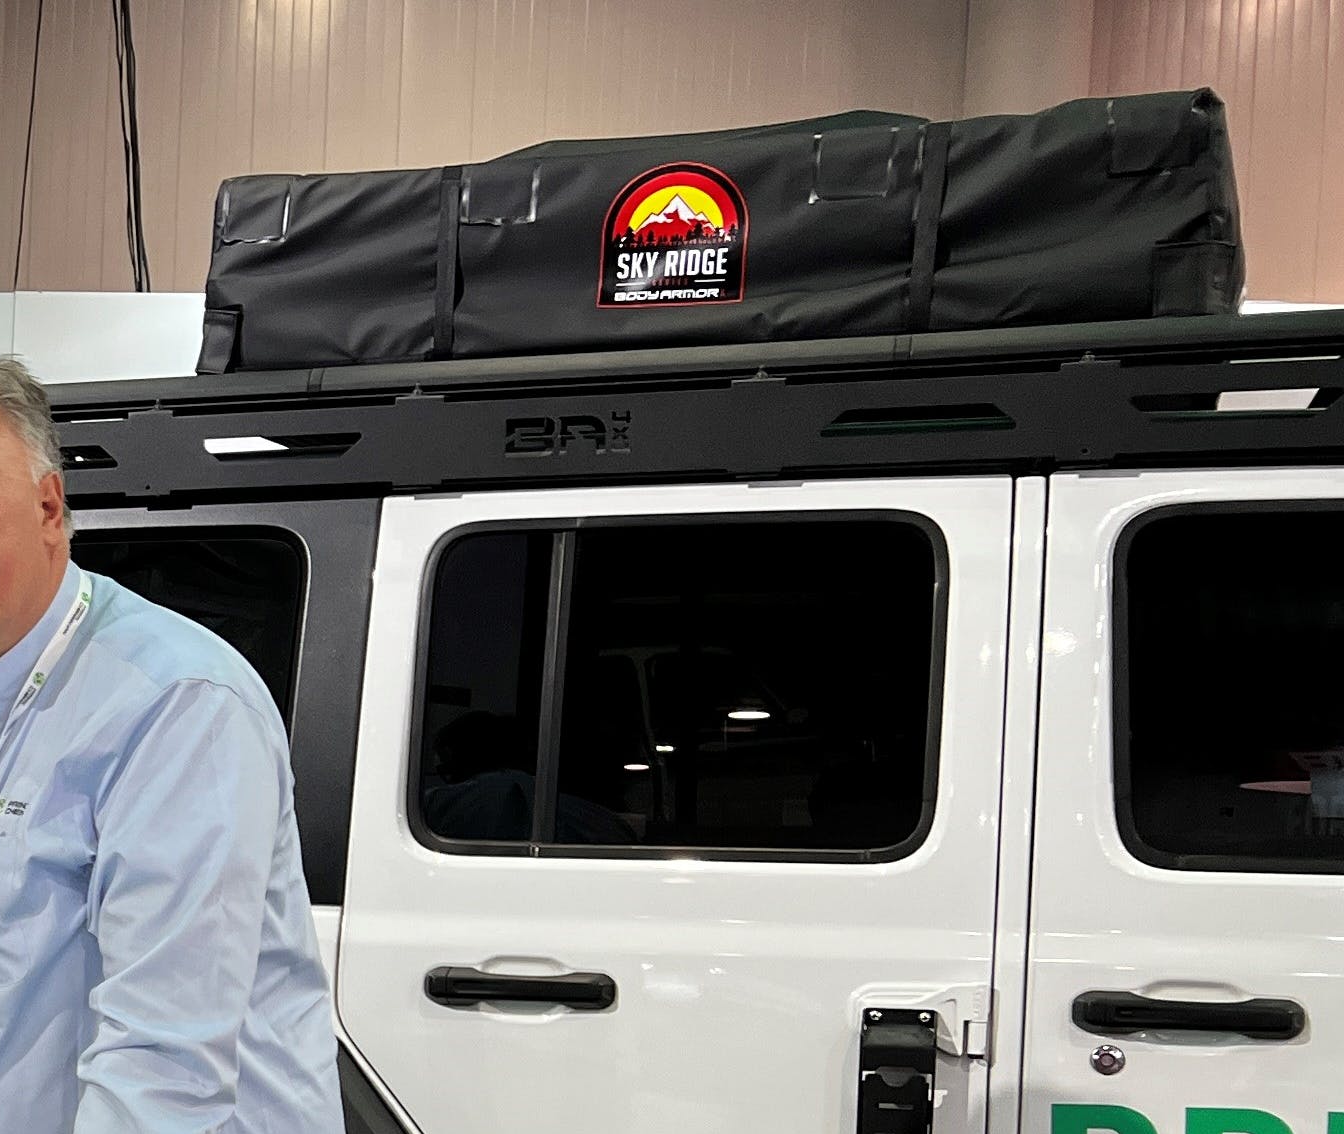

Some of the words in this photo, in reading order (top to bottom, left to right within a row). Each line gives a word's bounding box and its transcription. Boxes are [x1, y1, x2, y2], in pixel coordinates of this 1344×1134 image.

[616, 251, 659, 280] SKY
[664, 247, 729, 277] RIDGE
[614, 290, 659, 302] BODY
[660, 288, 719, 300] ARMOR
